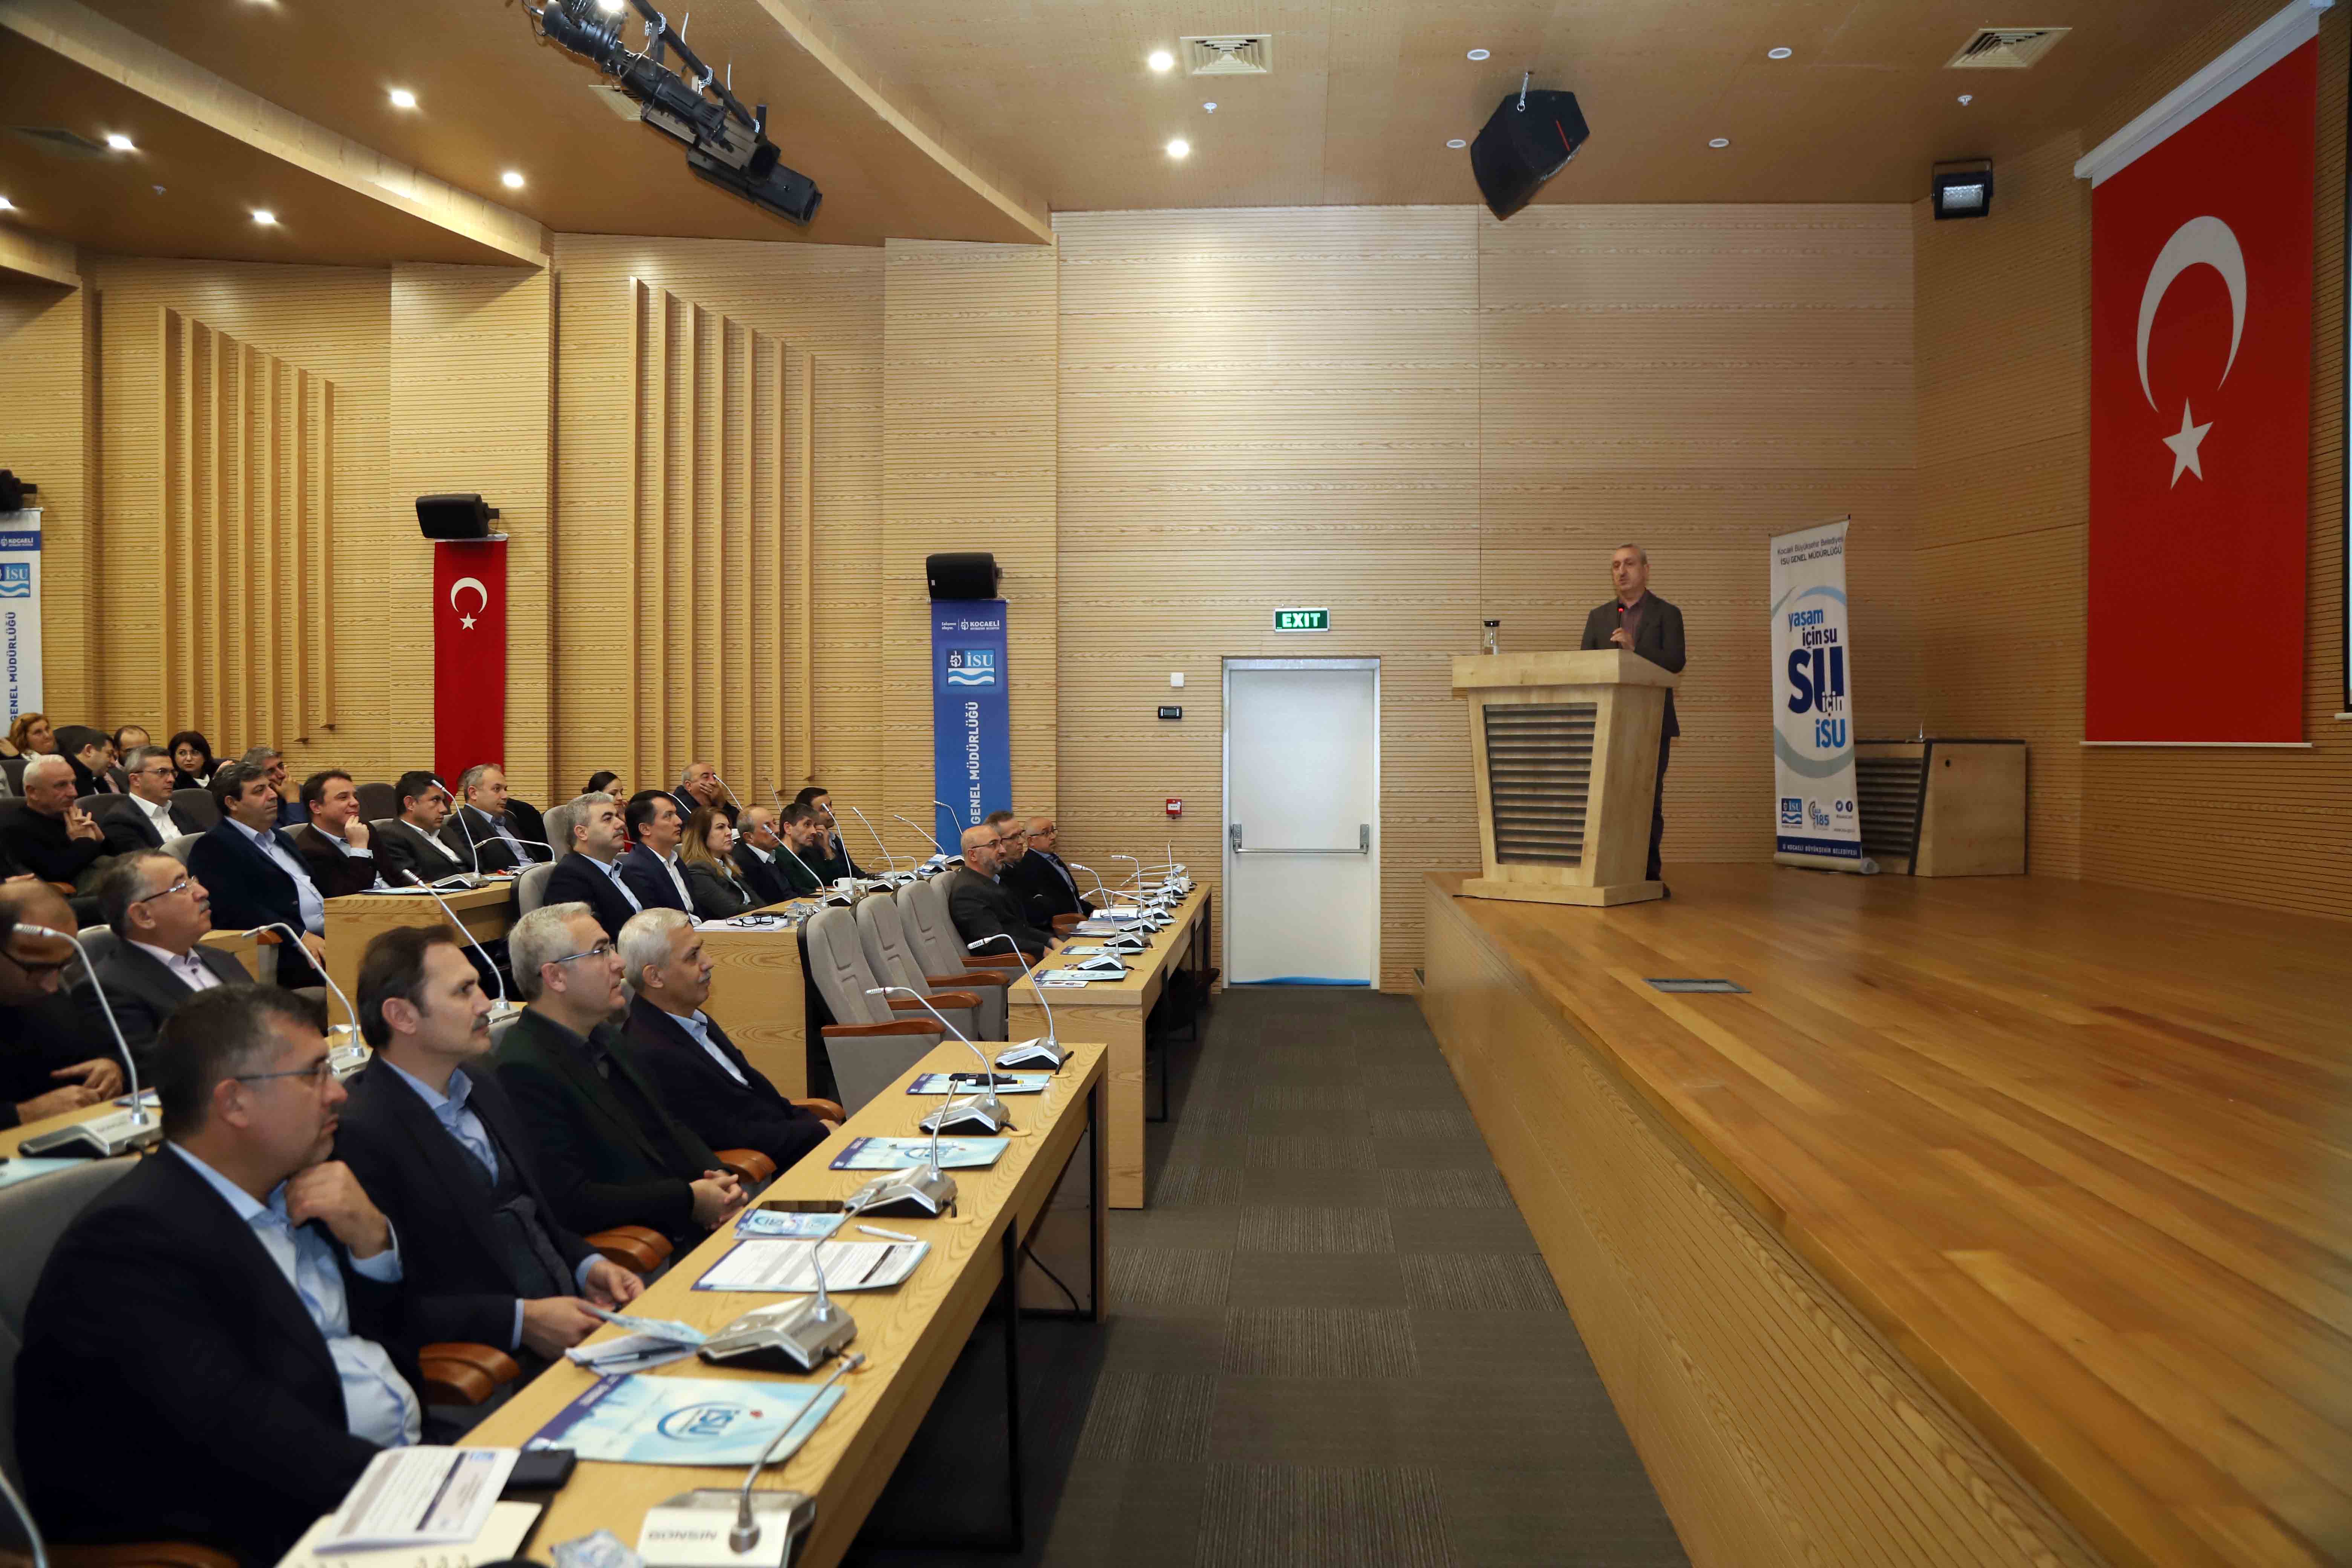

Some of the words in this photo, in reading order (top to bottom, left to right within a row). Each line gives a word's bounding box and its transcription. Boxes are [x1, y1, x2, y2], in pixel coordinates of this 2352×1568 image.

[1282, 613, 1320, 627] EXIT
[1802, 626, 1822, 649] için
[1824, 628, 1837, 643] su
[5, 612, 17, 682] MÜDÜRLÜĞÜ
[1788, 646, 1844, 714] SU
[9, 685, 18, 723] GENEL
[965, 701, 980, 780] MÜDÜRLÜĞÜ
[970, 783, 981, 824] GENEL
[1815, 815, 1829, 825] 185
